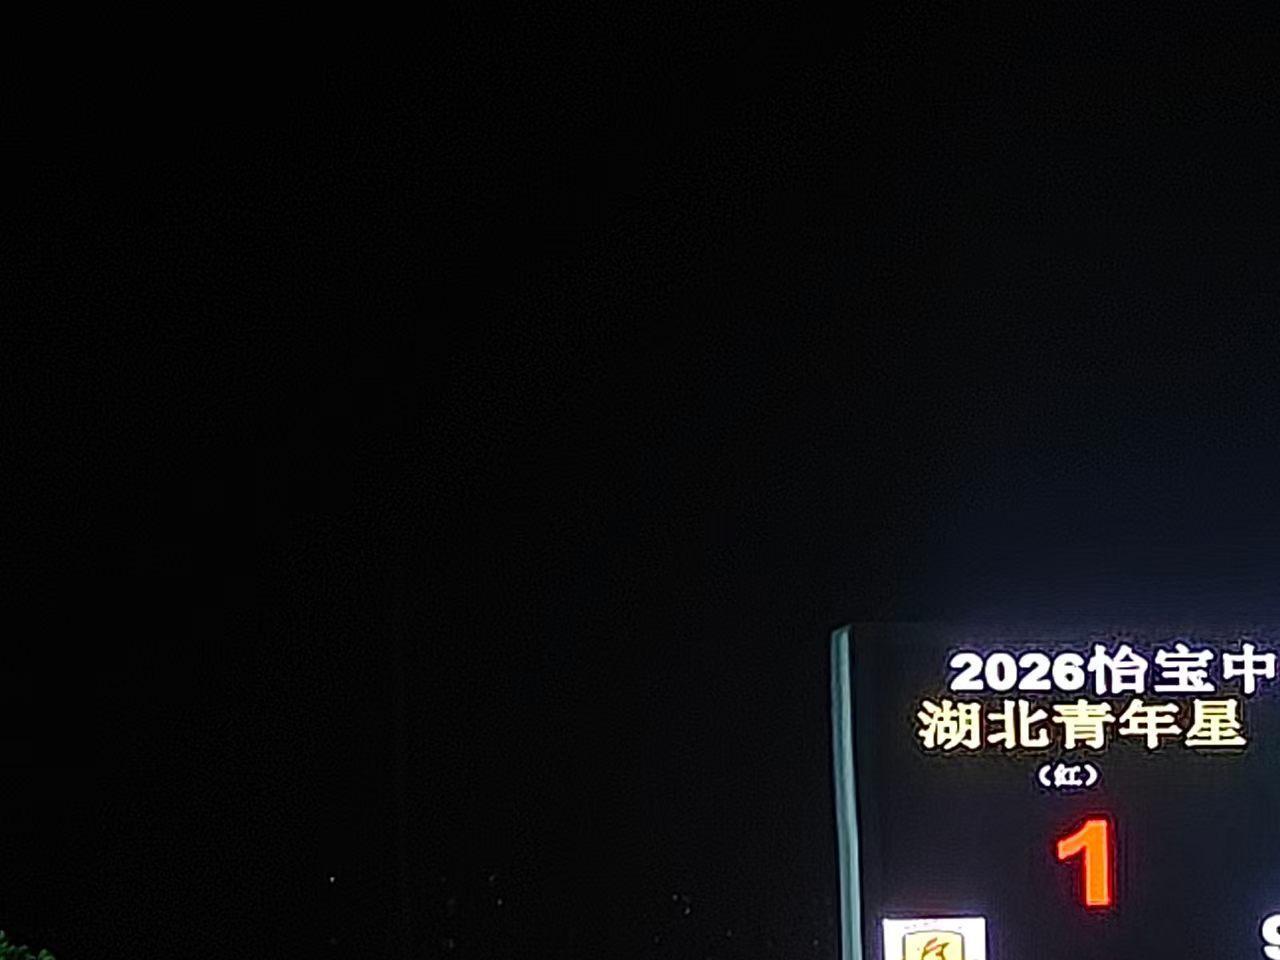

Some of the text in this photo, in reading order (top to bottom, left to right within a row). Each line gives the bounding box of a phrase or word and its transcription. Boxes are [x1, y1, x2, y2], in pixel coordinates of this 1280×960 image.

[917, 699, 1247, 750] 湖北青年星
[1037, 764, 1099, 788] (红)
[1056, 819, 1111, 907] 1
